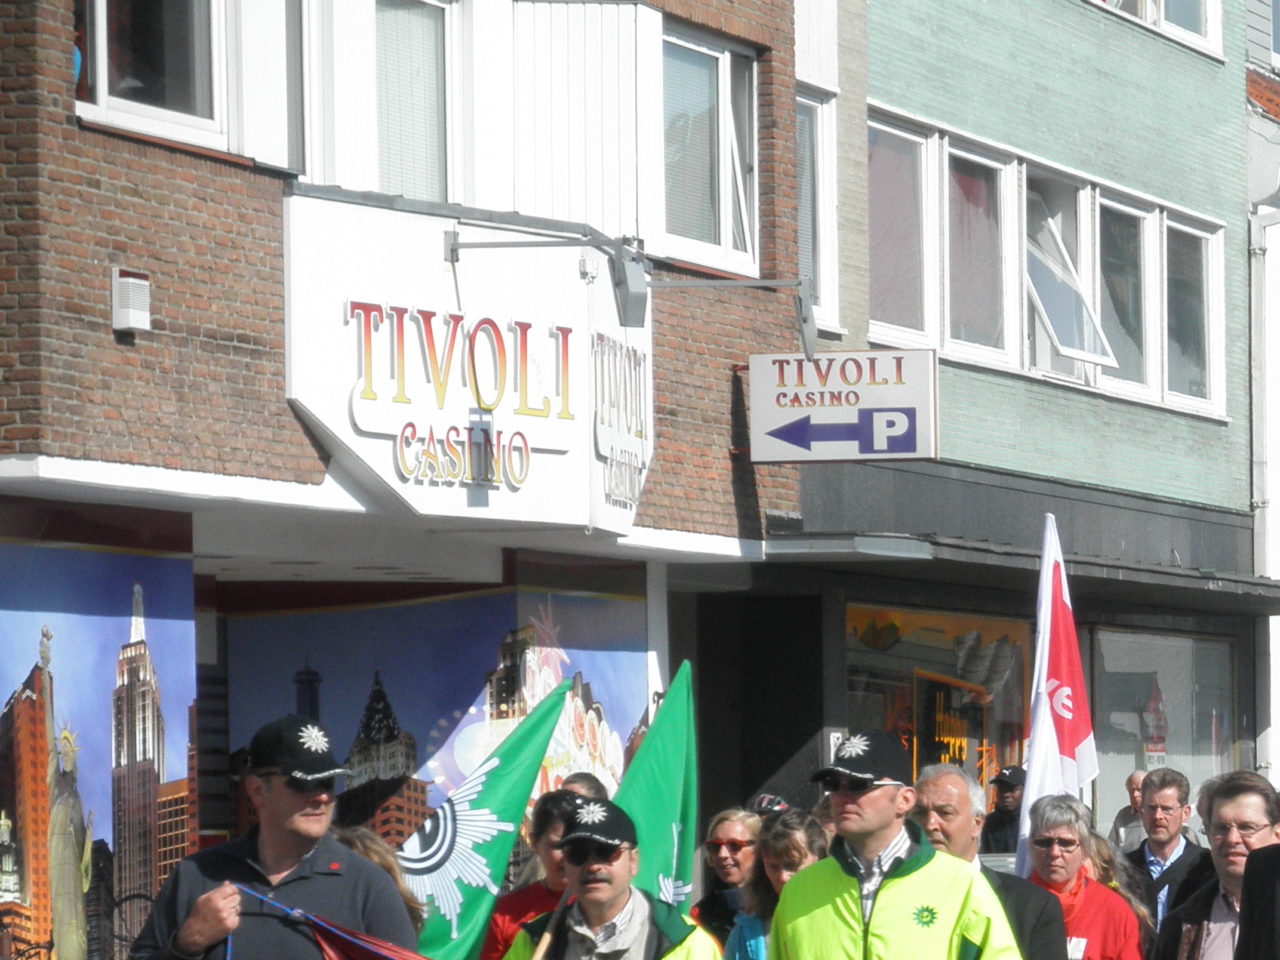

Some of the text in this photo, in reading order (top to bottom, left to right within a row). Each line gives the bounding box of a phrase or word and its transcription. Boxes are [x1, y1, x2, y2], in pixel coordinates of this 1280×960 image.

[348, 300, 575, 420] TIVOLI
[772, 356, 906, 388] TIVOLI
[776, 390, 860, 408] CASINO
[872, 410, 910, 451] P
[395, 421, 531, 488] CASINO
